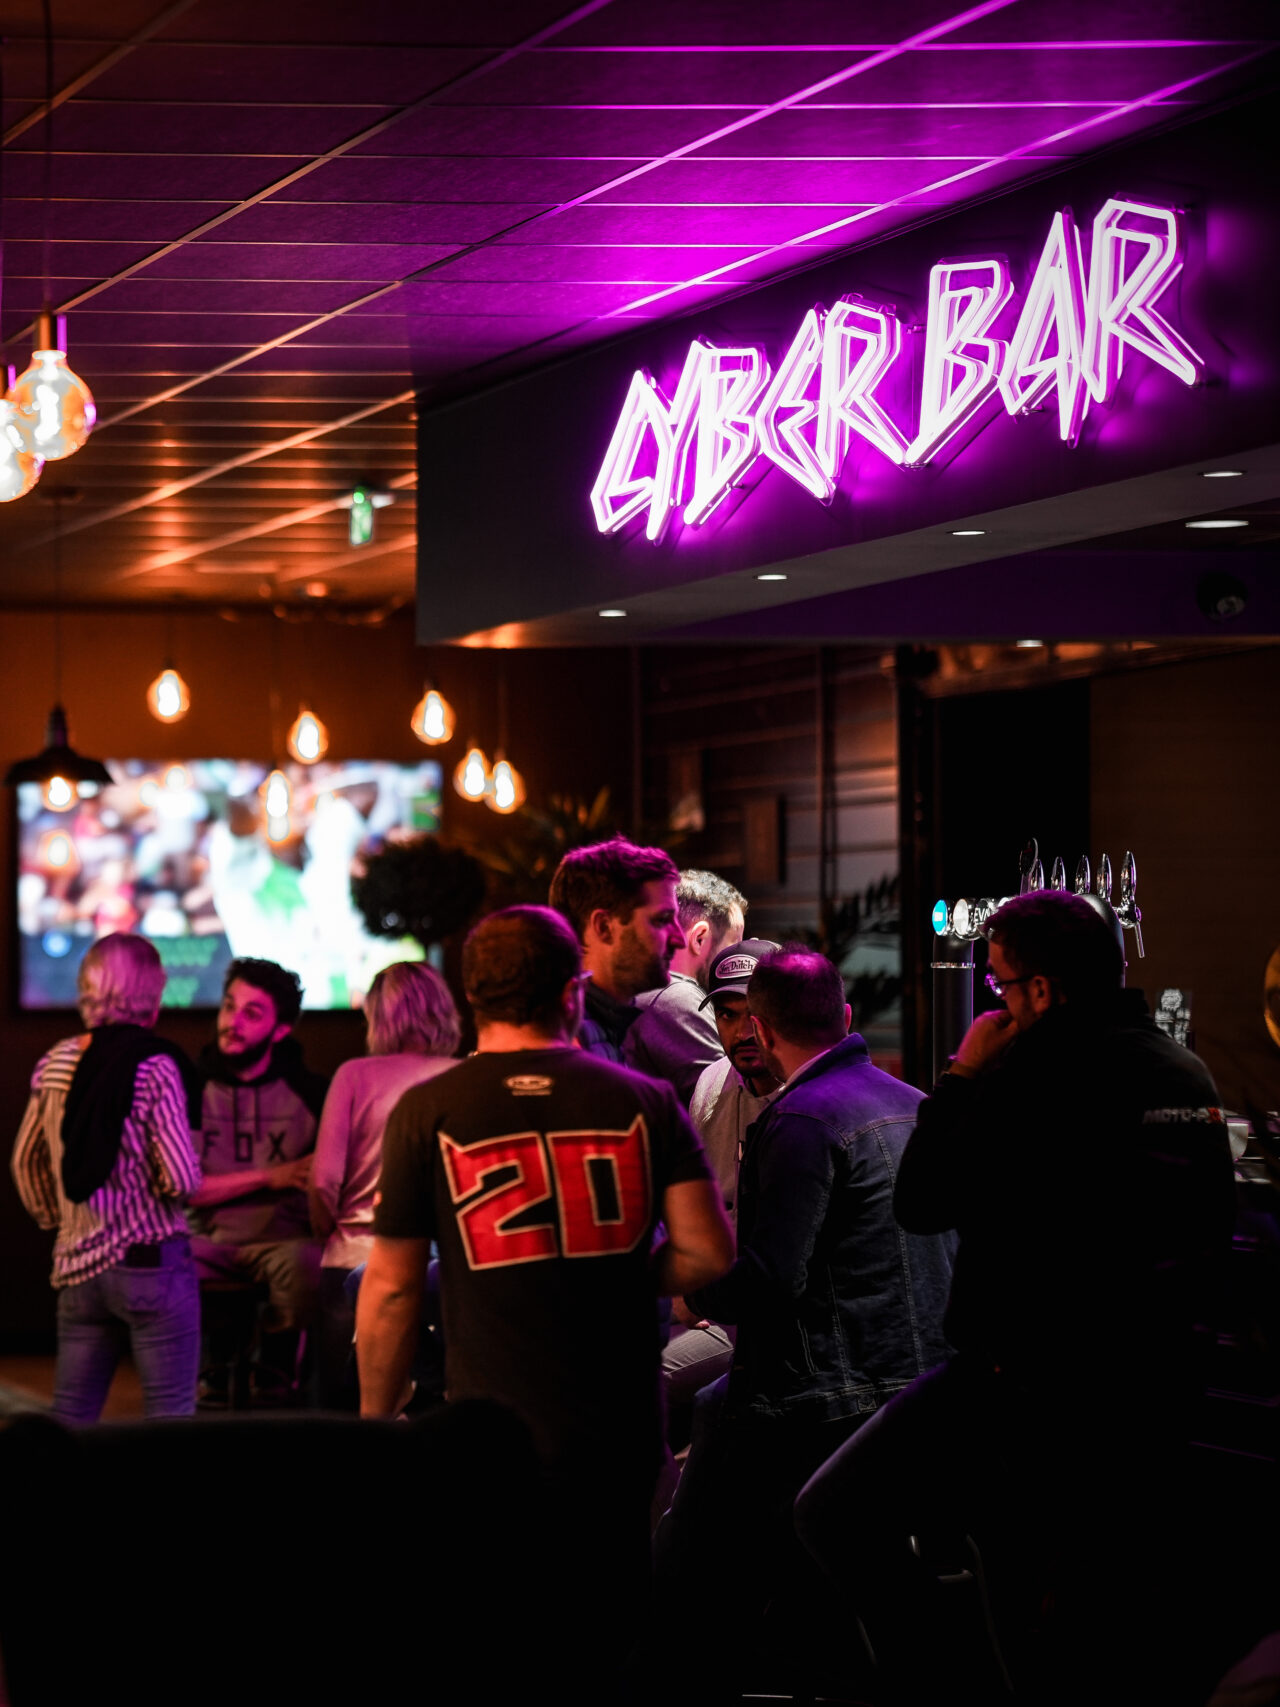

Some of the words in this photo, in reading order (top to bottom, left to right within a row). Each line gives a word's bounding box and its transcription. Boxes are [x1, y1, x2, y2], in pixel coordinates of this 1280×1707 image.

[590, 294, 908, 543] CYBER
[903, 198, 1206, 466] BAR
[203, 1131, 287, 1162] FOX
[437, 1112, 654, 1271] 20
